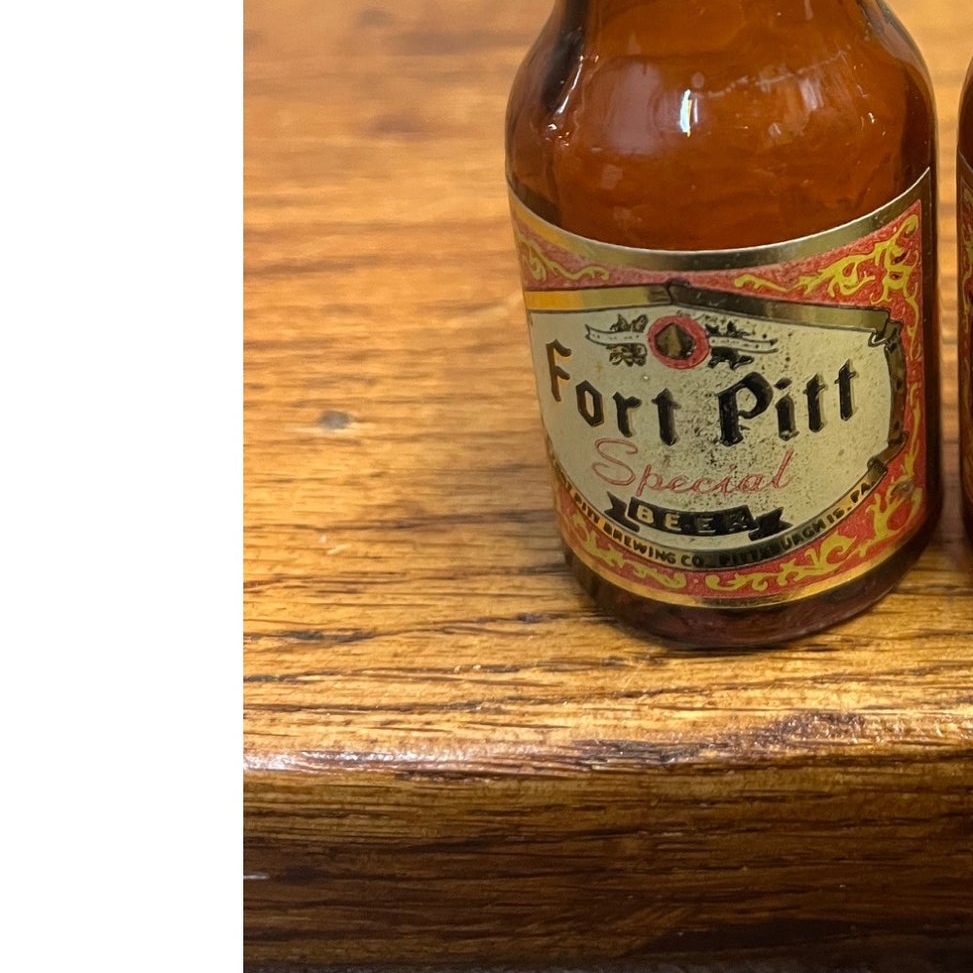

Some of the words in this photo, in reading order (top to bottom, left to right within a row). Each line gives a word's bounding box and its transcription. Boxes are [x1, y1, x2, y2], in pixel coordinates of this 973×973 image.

[546, 339, 681, 446] Fort
[717, 359, 859, 446] Pitt
[592, 437, 795, 496] Special
[603, 521, 677, 565] BREWING
